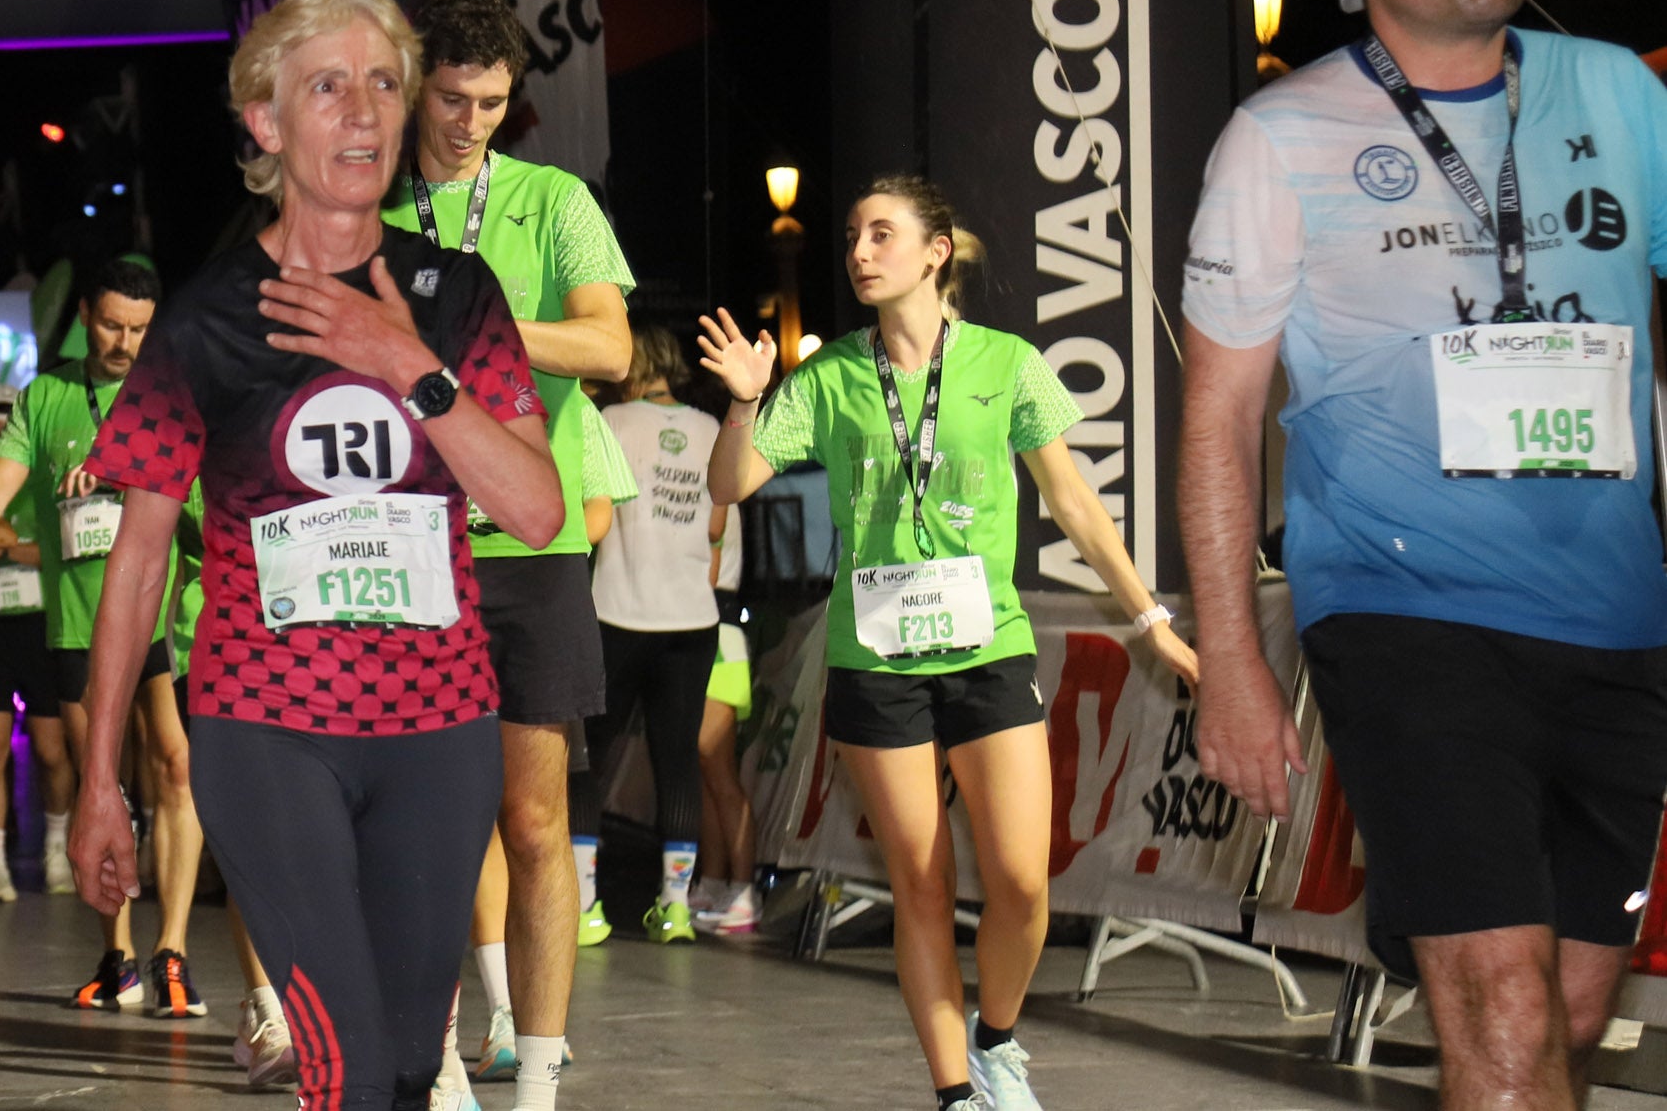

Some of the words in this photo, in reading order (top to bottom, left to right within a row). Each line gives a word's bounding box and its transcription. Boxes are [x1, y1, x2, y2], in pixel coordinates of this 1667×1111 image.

[1441, 329, 1479, 356] 10K
[1508, 408, 1595, 454] 1495
[301, 419, 392, 481] TRI
[1037, 336, 1126, 594] ARIO
[260, 514, 291, 541] 10K
[429, 511, 439, 532] 3
[76, 528, 112, 549] 1055
[328, 541, 390, 561] MARIAJE
[856, 569, 878, 586] 10K
[971, 565, 979, 579] 3
[316, 566, 411, 607] F1251
[901, 591, 944, 608] NAGORE
[898, 611, 954, 644] F213
